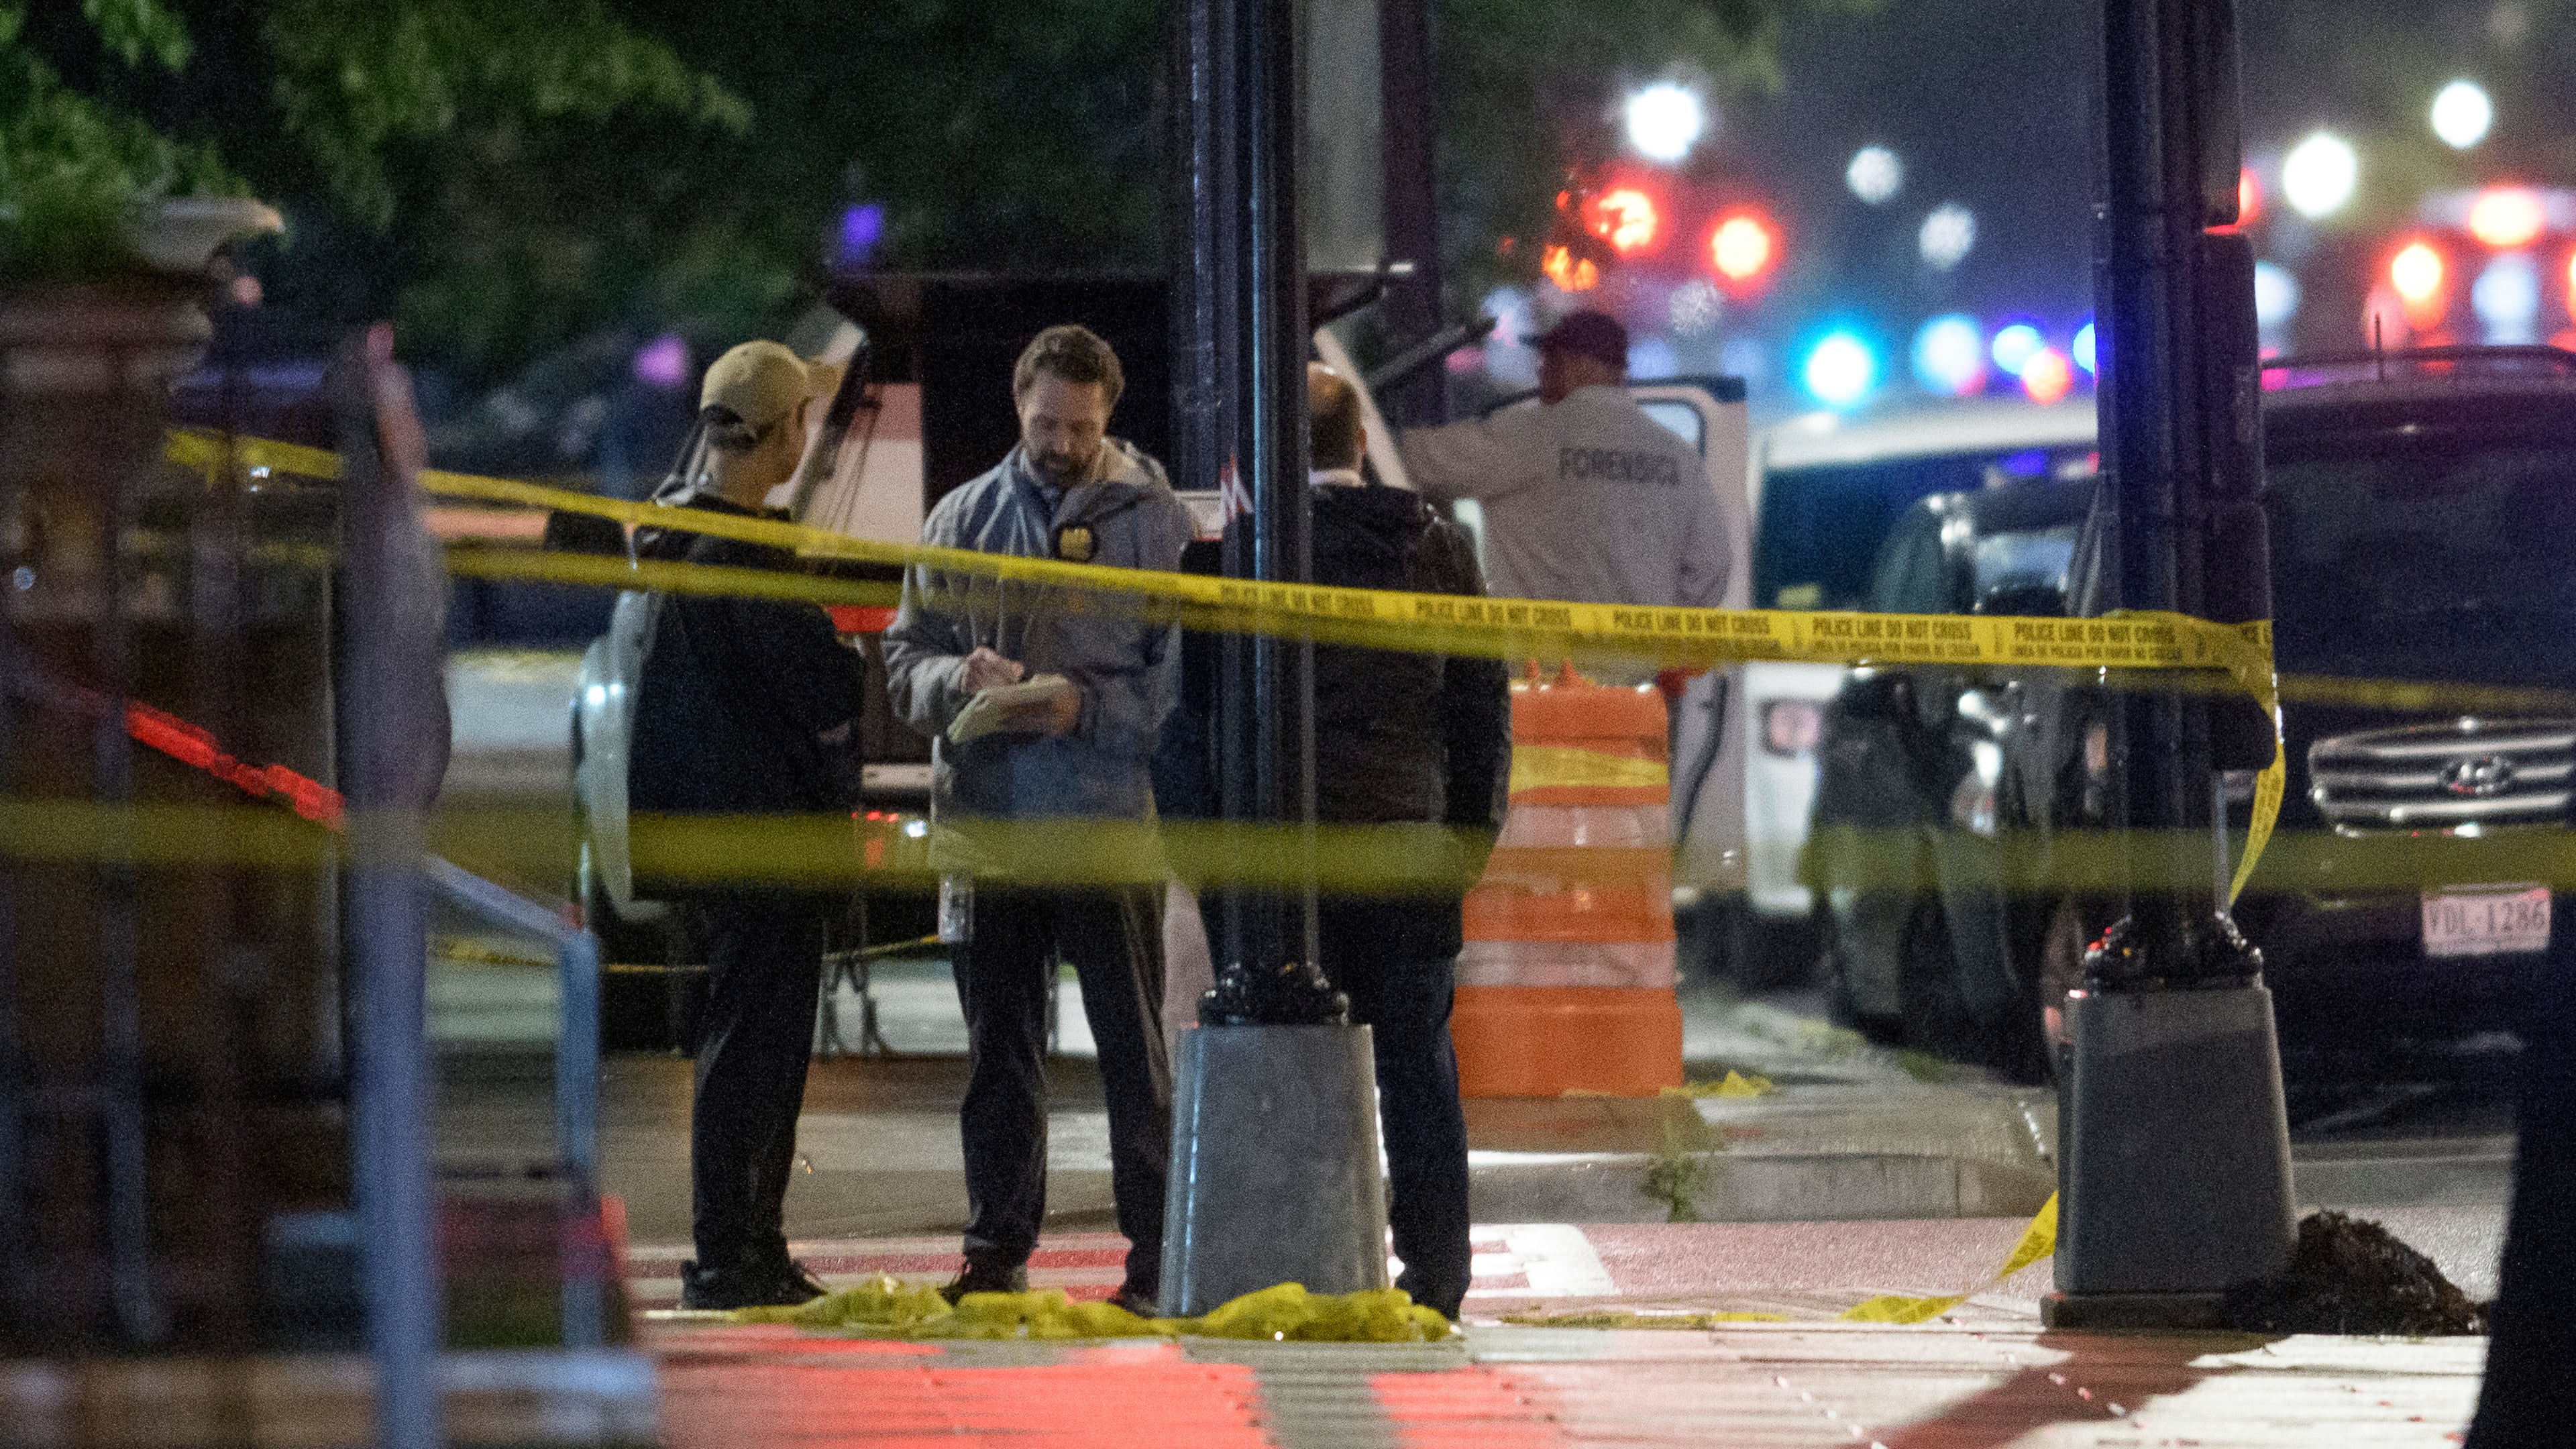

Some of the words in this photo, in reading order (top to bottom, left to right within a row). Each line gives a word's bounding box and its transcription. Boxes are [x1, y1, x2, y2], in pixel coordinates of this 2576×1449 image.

[1559, 447, 1680, 486] FORENSICS
[1415, 600, 1454, 620] POLICE
[1459, 604, 1483, 623] LINE
[1487, 604, 1504, 623] DO
[1507, 605, 1528, 624] NOT
[1613, 610, 1652, 629] POLICE
[1656, 612, 1681, 631] LINE
[1685, 613, 1701, 631] DO
[1705, 614, 1727, 633] NOT
[1731, 615, 1770, 634] CROSS
[1813, 616, 1852, 636] POLICE
[1856, 619, 1882, 637] LINE
[1885, 619, 1902, 637] DO
[1906, 620, 1929, 639] NOT
[1932, 621, 1972, 640] CROSS
[2014, 623, 2055, 641] POLICE
[2059, 625, 2084, 642] LINE
[2088, 624, 2105, 642] DO
[2108, 625, 2130, 642] NOT
[2134, 625, 2176, 643] CROSS
